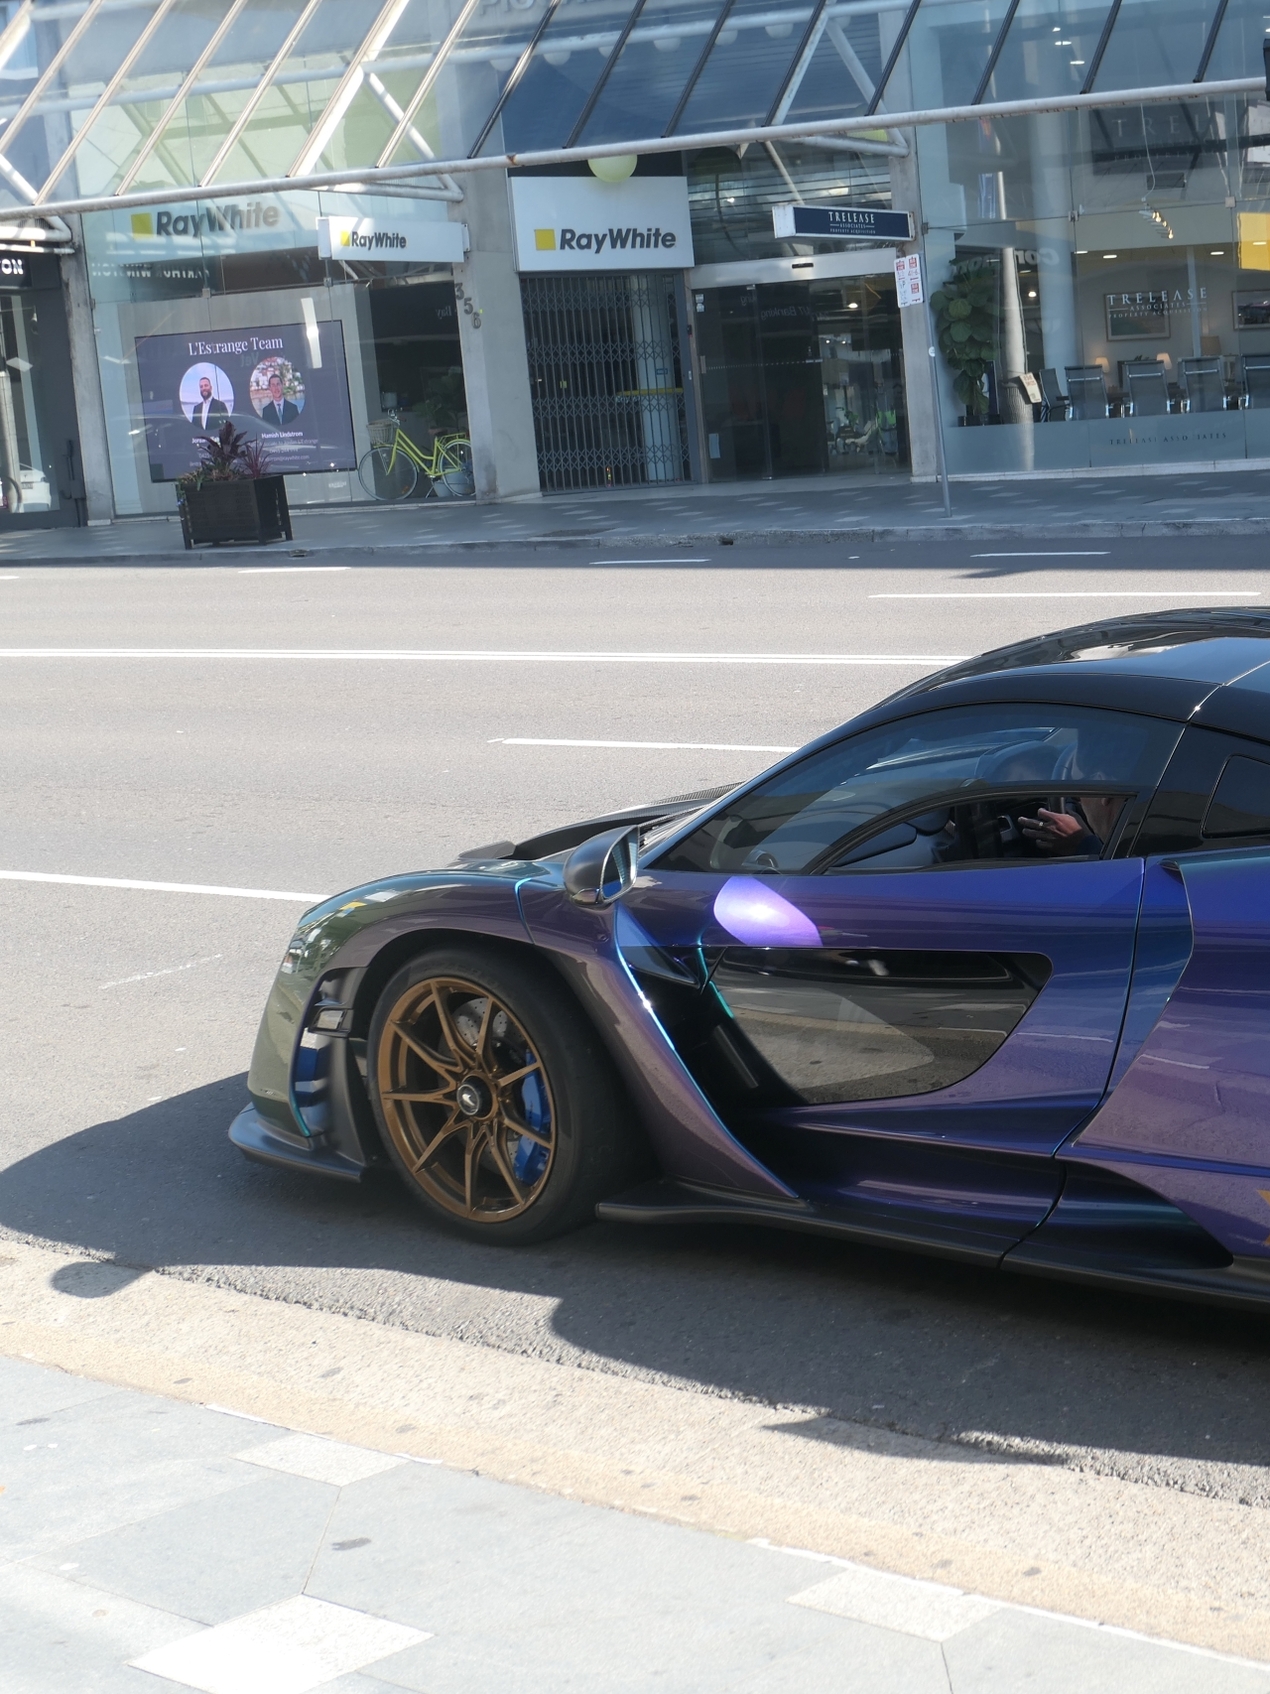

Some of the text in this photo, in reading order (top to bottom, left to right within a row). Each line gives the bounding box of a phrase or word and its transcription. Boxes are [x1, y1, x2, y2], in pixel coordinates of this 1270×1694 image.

[156, 201, 280, 238] RayWhite
[828, 211, 875, 224] TRELEASE
[351, 231, 407, 251] RayWhite
[559, 228, 677, 254] RayWhite
[1107, 287, 1207, 306] TRELEASE
[1130, 301, 1186, 311] ASSOCIATES
[1108, 310, 1149, 319] PROPERTY
[188, 336, 284, 357] L'Estrange Team
[1163, 432, 1227, 443] ASSOIATES
